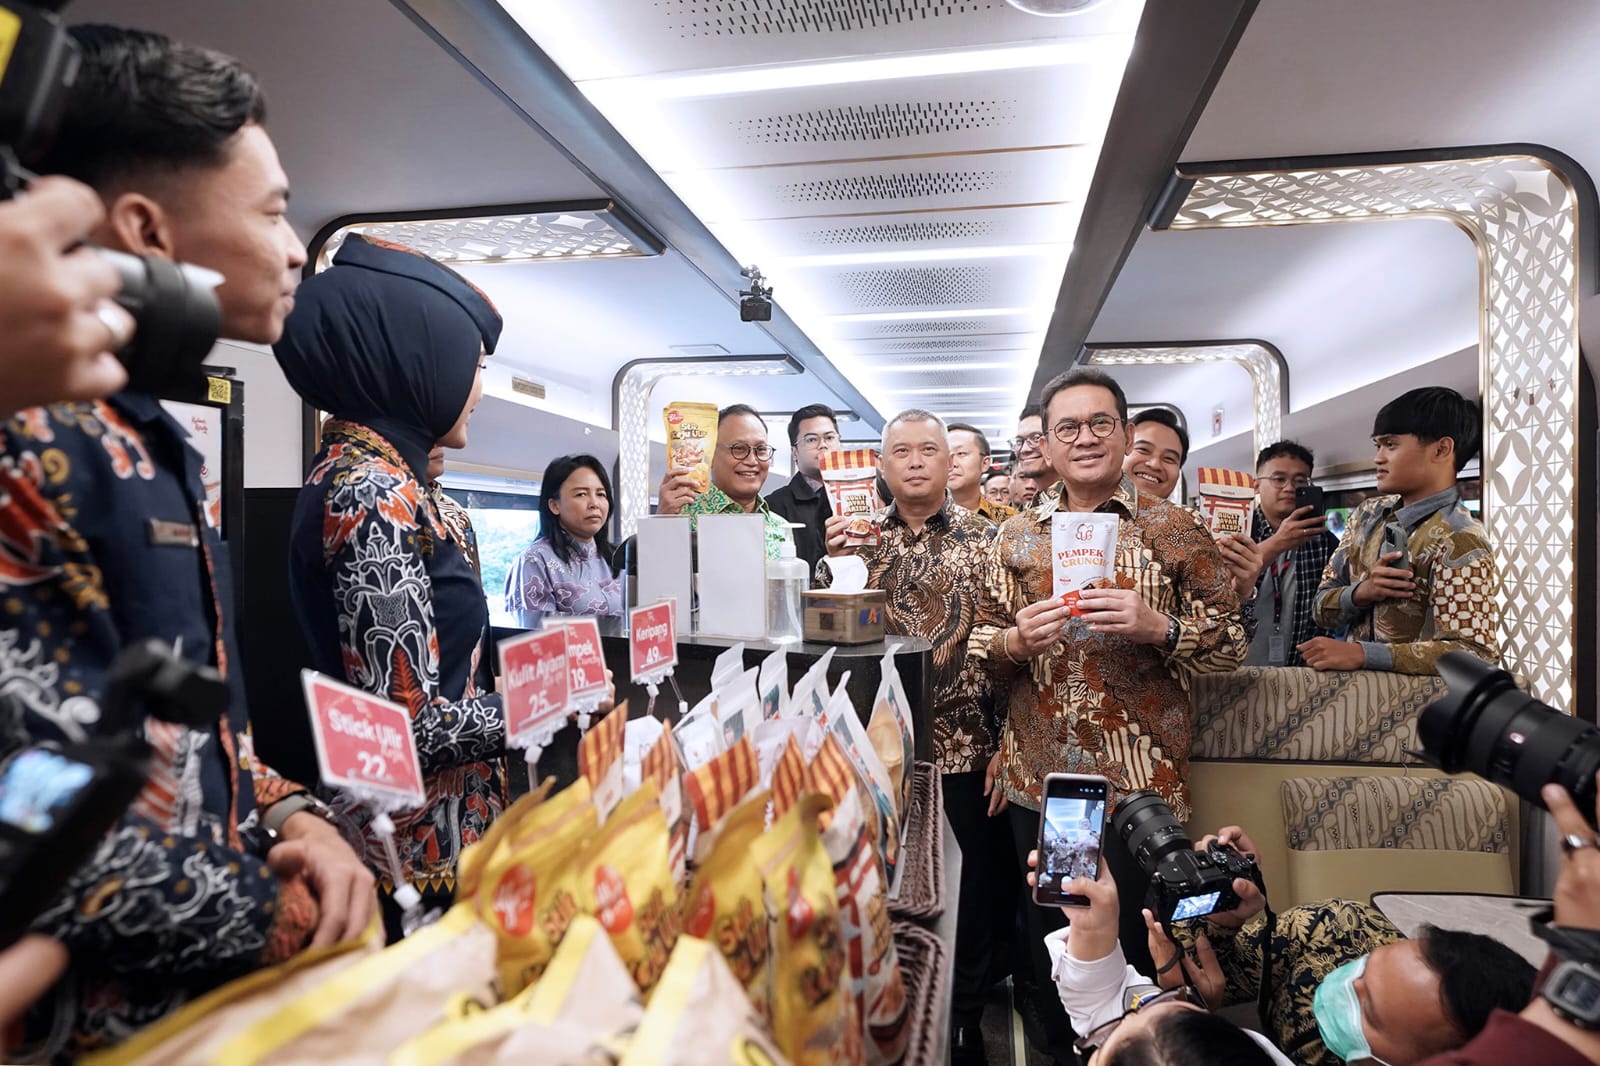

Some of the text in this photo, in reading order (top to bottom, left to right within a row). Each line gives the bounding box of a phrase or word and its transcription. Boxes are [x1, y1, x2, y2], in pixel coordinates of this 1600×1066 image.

[1057, 548, 1104, 560] PEMPEK
[635, 622, 668, 643] Keripang
[568, 641, 593, 659] mpek
[508, 662, 536, 691] Kulit
[536, 653, 566, 682] Ayam
[328, 707, 378, 743] Stick
